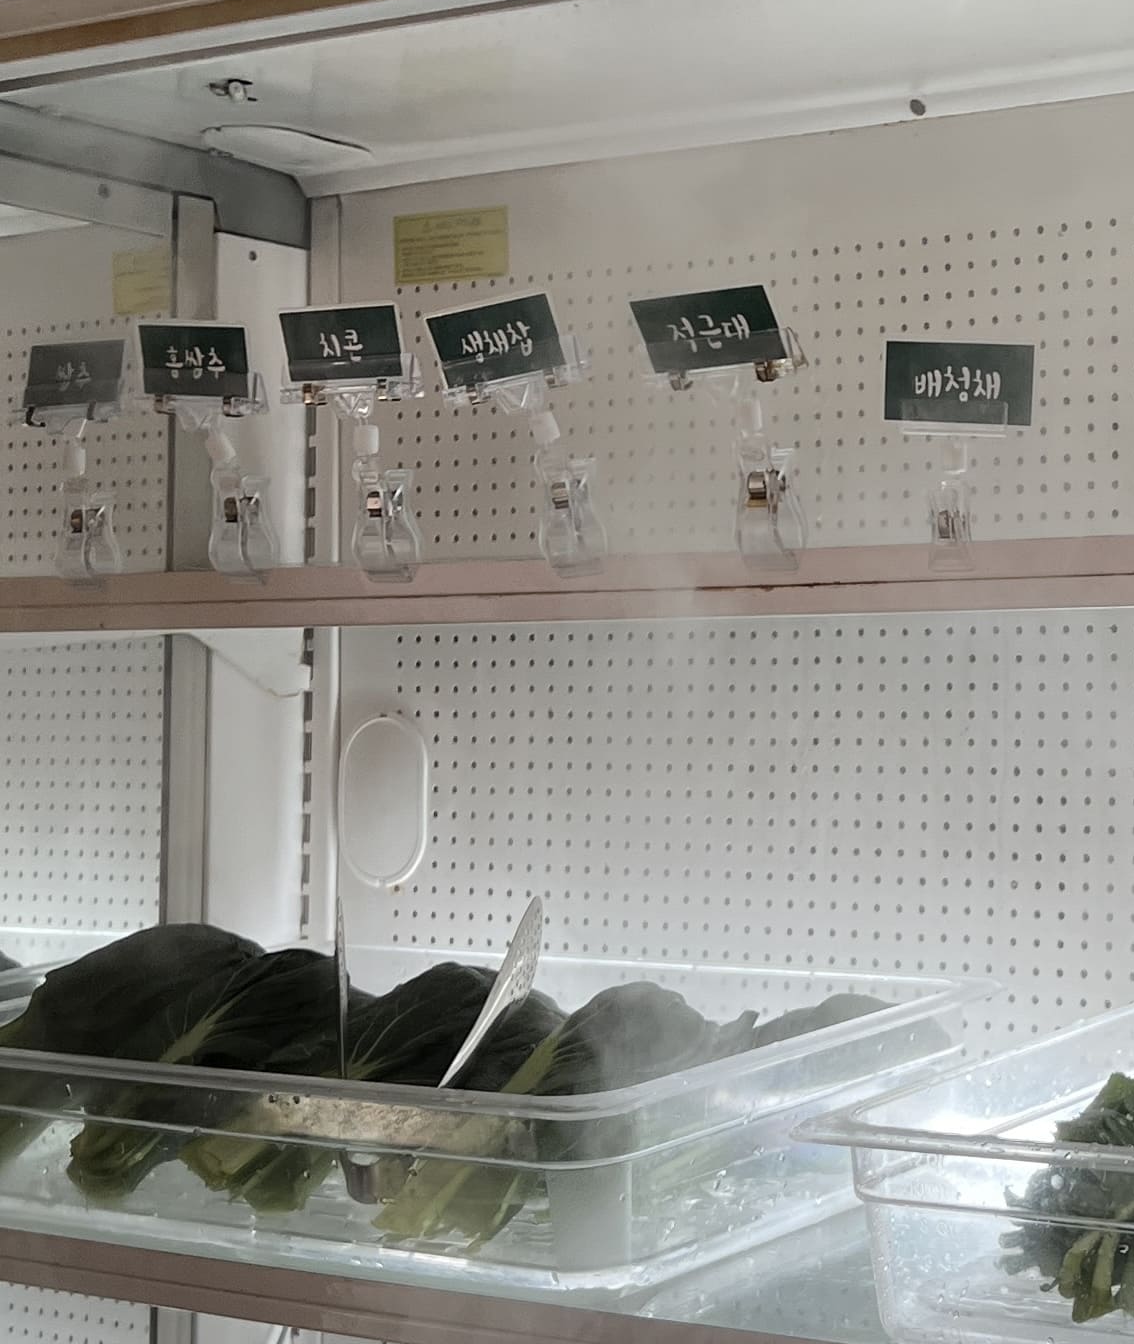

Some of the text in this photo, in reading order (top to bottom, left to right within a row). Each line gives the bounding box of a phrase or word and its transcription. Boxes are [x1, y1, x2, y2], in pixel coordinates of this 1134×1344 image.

[319, 328, 364, 362] 치콘
[667, 313, 752, 353] 적근대
[913, 364, 1002, 403] 배청채
